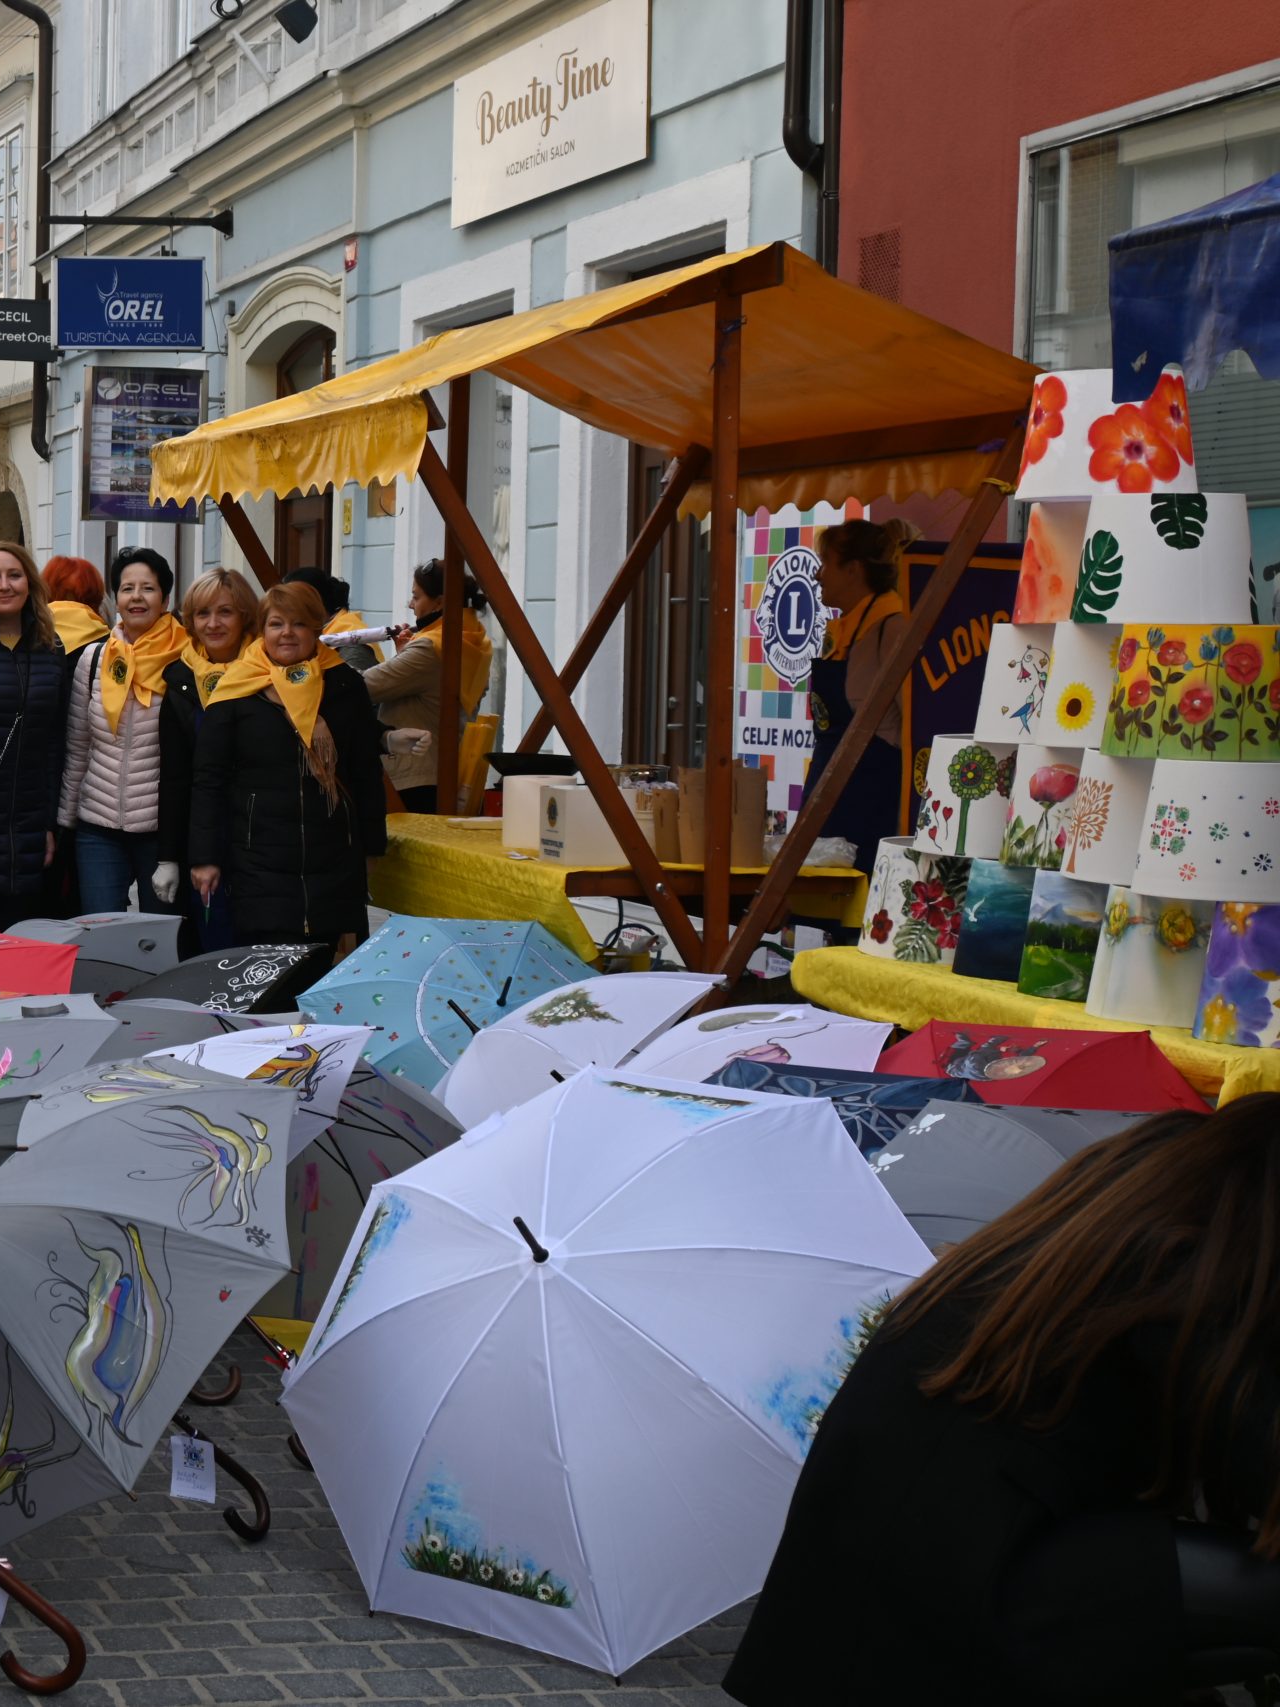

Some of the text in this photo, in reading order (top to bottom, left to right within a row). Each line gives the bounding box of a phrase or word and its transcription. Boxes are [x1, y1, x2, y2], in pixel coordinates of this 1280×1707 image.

[476, 48, 615, 145] Beauty Time
[506, 139, 576, 177] KOZMETIČNI SALON
[120, 291, 164, 300] Travel agency
[108, 299, 164, 320] OREL
[27, 331, 51, 343] One
[64, 329, 197, 343] TURISTIČNA AGENCIJA
[123, 382, 197, 396] OREL
[775, 555, 818, 581] LIONS
[787, 591, 806, 635] L
[772, 648, 812, 669] INTERNATIONAL
[742, 727, 778, 746] CELJE
